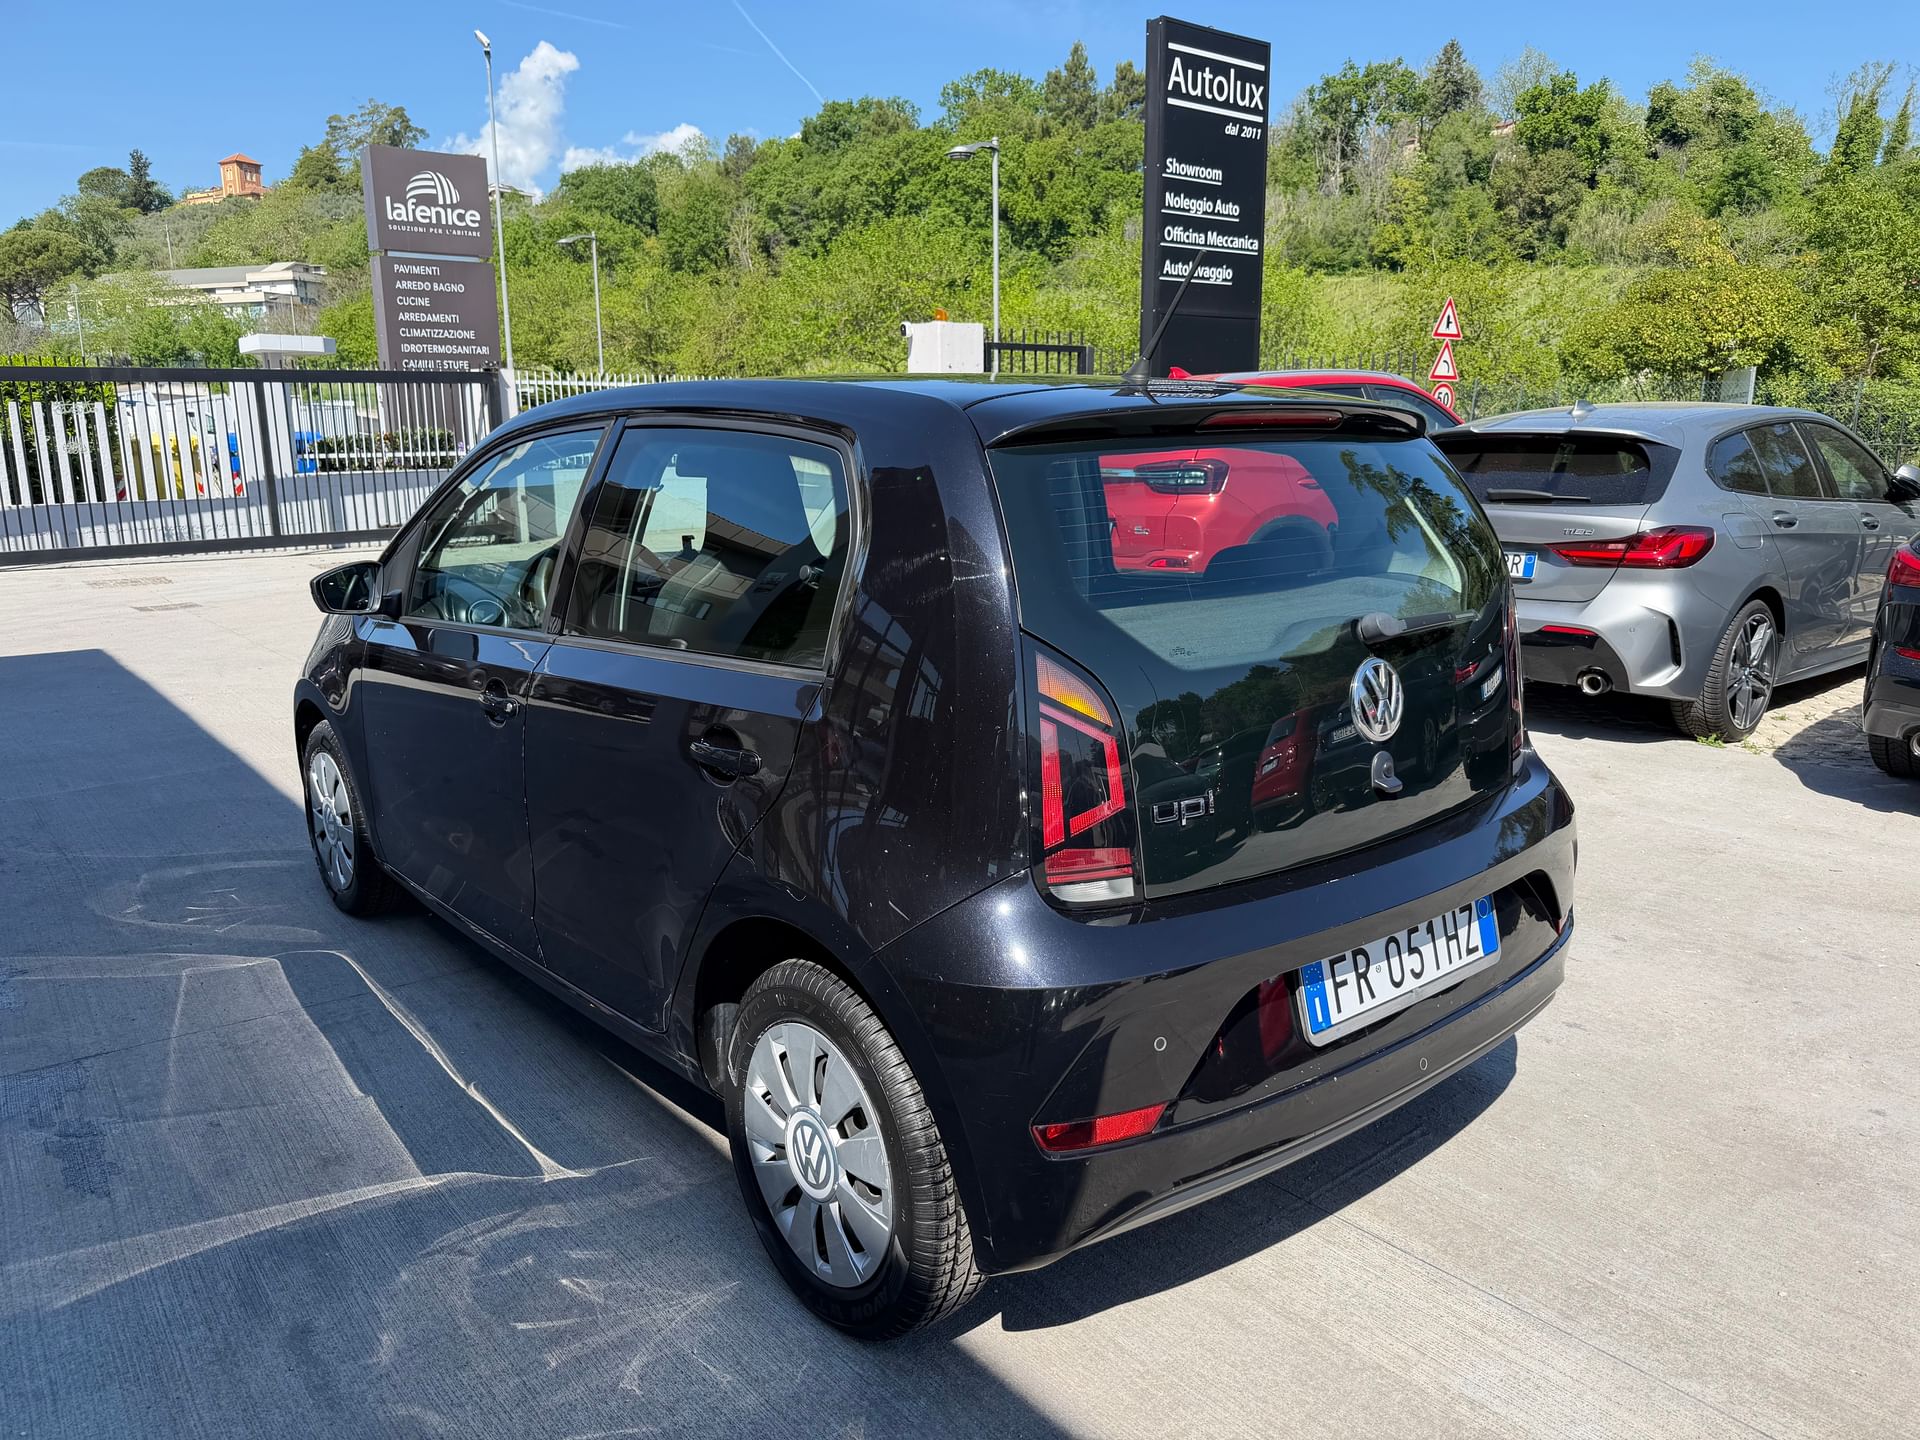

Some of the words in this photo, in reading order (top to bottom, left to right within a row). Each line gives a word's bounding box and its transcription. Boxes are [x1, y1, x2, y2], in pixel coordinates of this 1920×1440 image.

[1167, 57, 1265, 111] Autolux
[1224, 122, 1239, 136] dal
[1240, 125, 1262, 140] 2011
[1165, 157, 1223, 181] Showroom
[1165, 191, 1214, 215] Noleggio
[1214, 199, 1240, 216] Auto
[385, 196, 481, 228] lafenice
[388, 224, 427, 233] SOLUZIONI
[429, 227, 443, 235] PER
[1164, 225, 1205, 245] Officina
[1206, 231, 1259, 251] Meccanica
[393, 263, 440, 276] PAVIMENTI
[1163, 259, 1233, 281] Autolvaggio
[395, 280, 432, 292] ARREDO
[433, 282, 465, 293] BAGNO
[396, 296, 431, 307] CUCINE
[398, 311, 460, 324] ARREDAMENTI
[399, 327, 476, 340] CLIMATIZZAZIONE
[401, 343, 490, 355] IDROTERMOSANITARI
[443, 360, 469, 370] STUFE
[1437, 392, 1450, 407] 50
[1328, 947, 1376, 1014] FR
